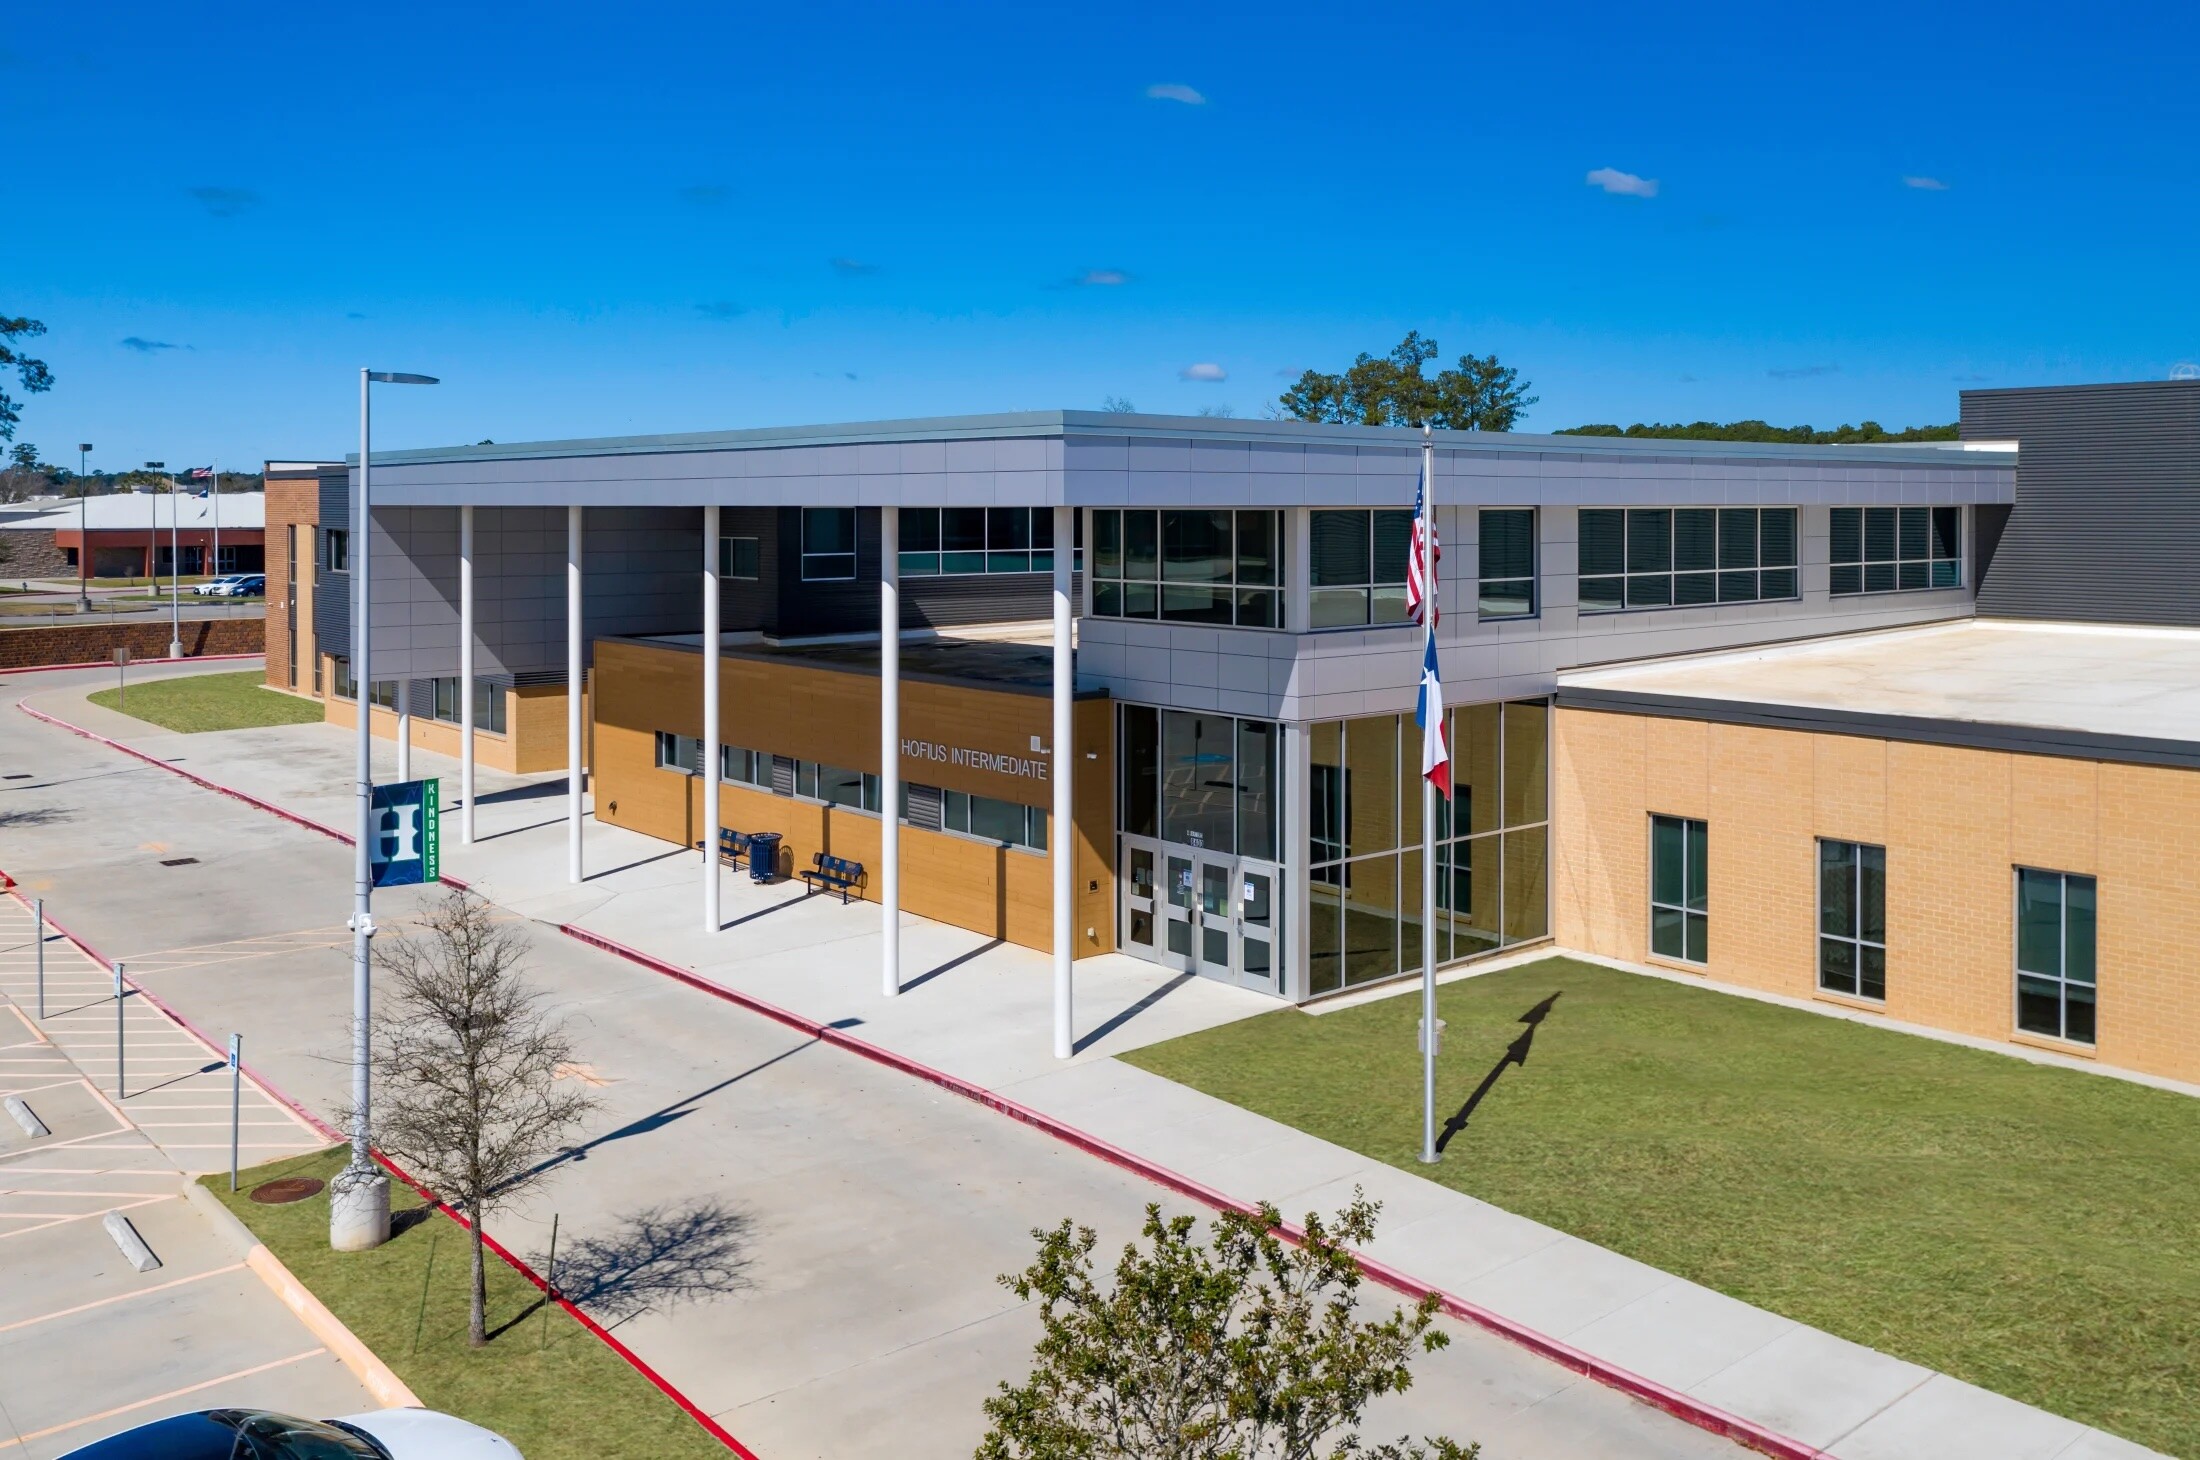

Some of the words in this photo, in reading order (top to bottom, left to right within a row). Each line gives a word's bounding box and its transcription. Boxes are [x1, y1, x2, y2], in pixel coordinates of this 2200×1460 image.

[901, 738, 947, 762] HOFIUS
[951, 747, 1047, 780] INTERMEDIATE
[428, 784, 436, 877] KINDNESS
